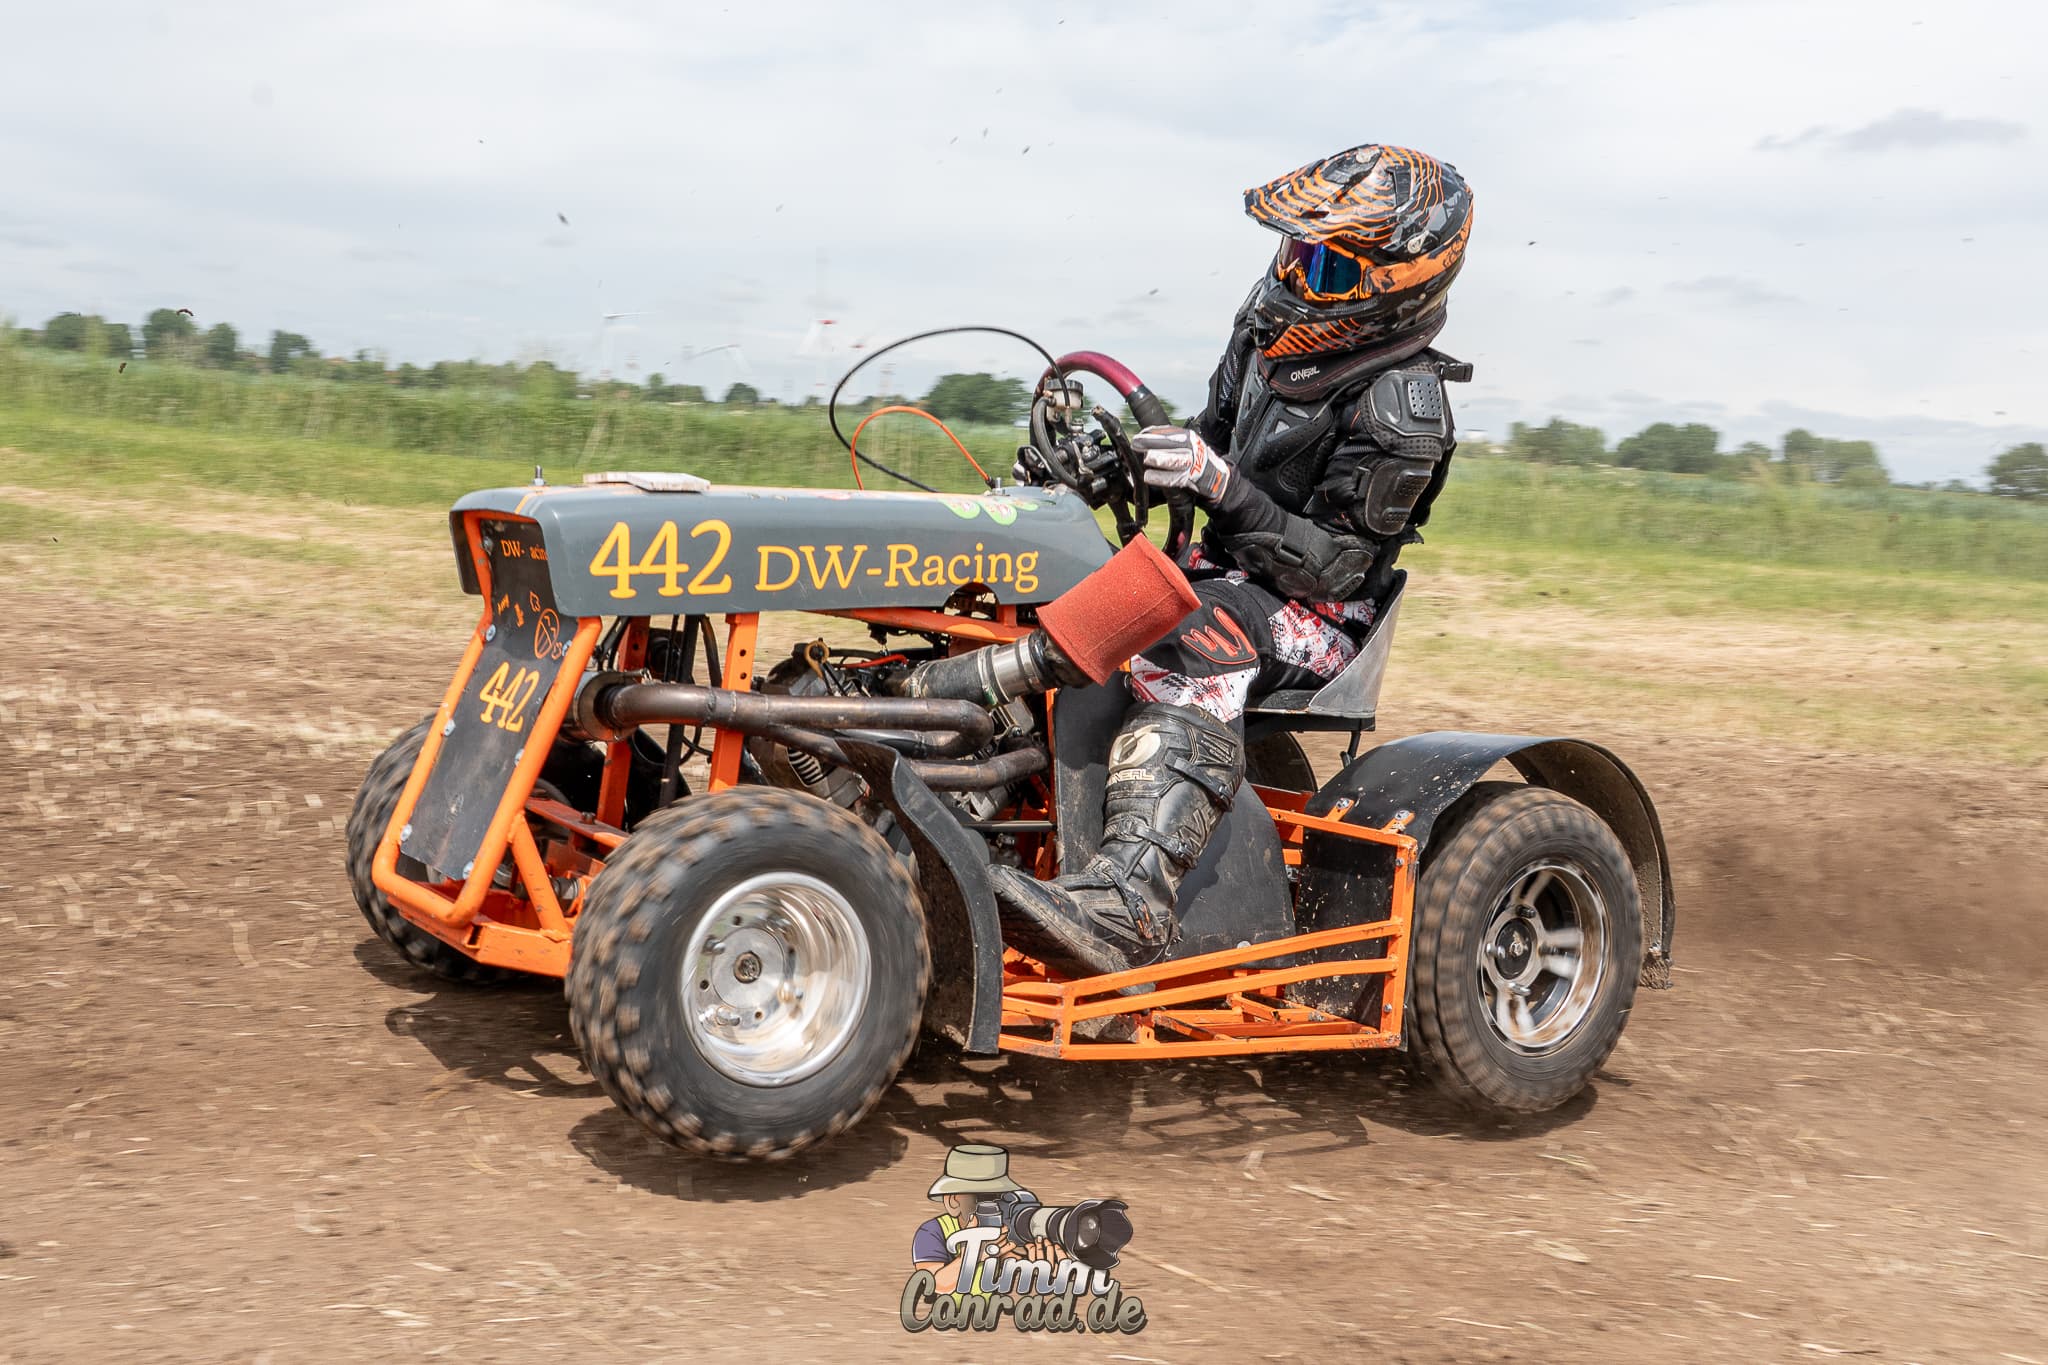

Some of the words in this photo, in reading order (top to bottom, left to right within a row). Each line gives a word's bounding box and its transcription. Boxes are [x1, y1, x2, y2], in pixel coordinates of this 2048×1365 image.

[588, 519, 732, 599] 442
[756, 542, 1039, 592] DW-Racing
[479, 661, 541, 733] 442
